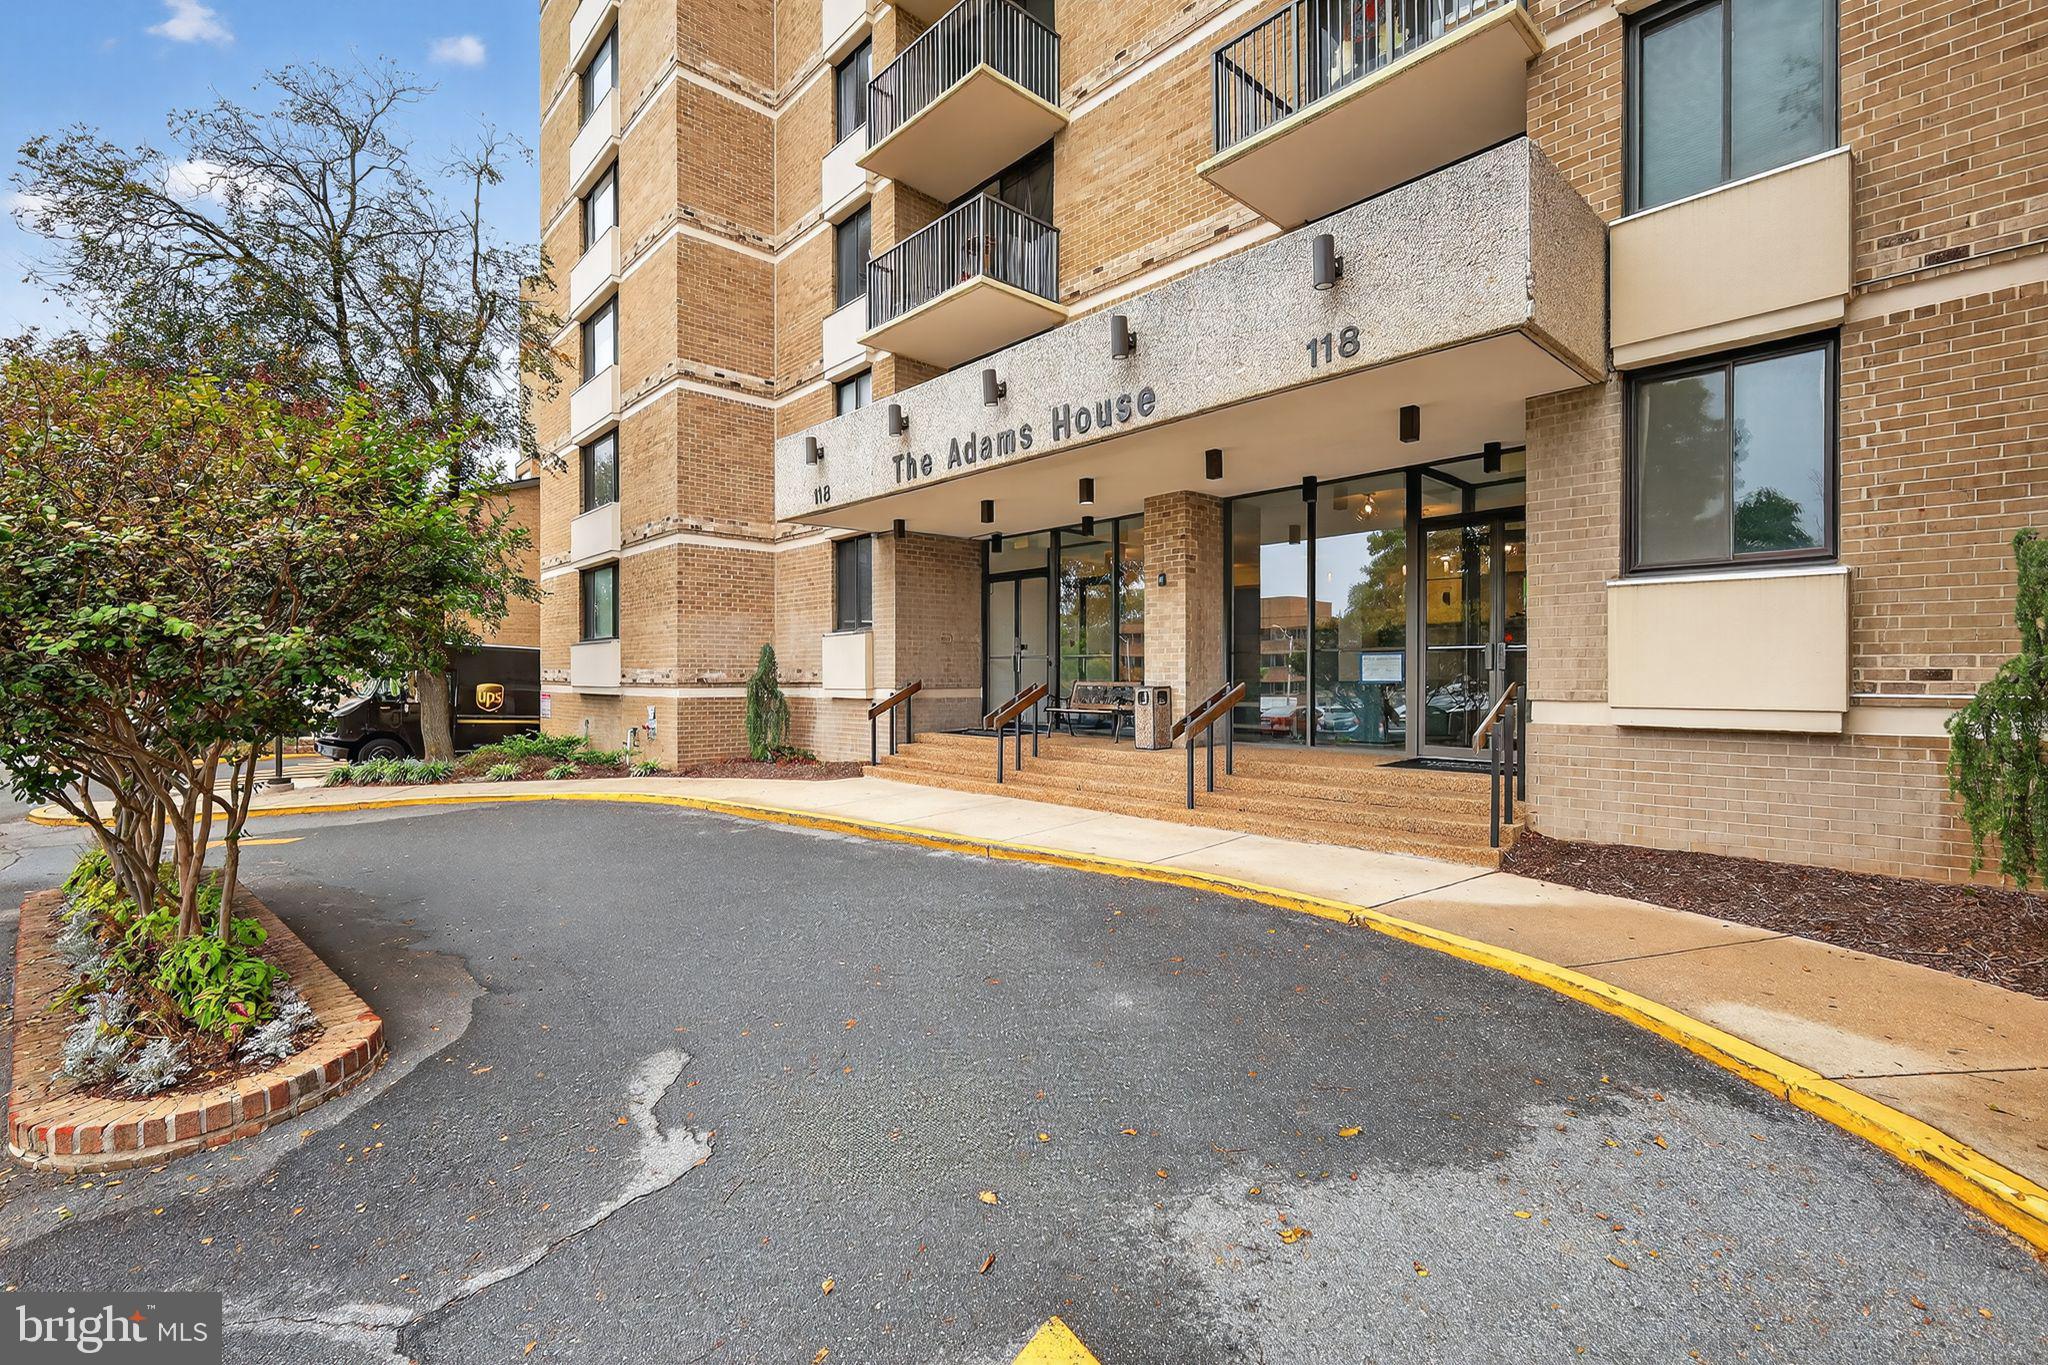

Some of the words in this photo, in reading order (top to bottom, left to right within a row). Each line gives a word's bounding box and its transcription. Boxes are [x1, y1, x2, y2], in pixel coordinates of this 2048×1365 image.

[1306, 325, 1361, 368] 118
[892, 451, 933, 484] The
[947, 422, 1033, 469] Adams
[1051, 386, 1156, 441] House
[813, 484, 831, 505] 118
[478, 691, 502, 708] ups
